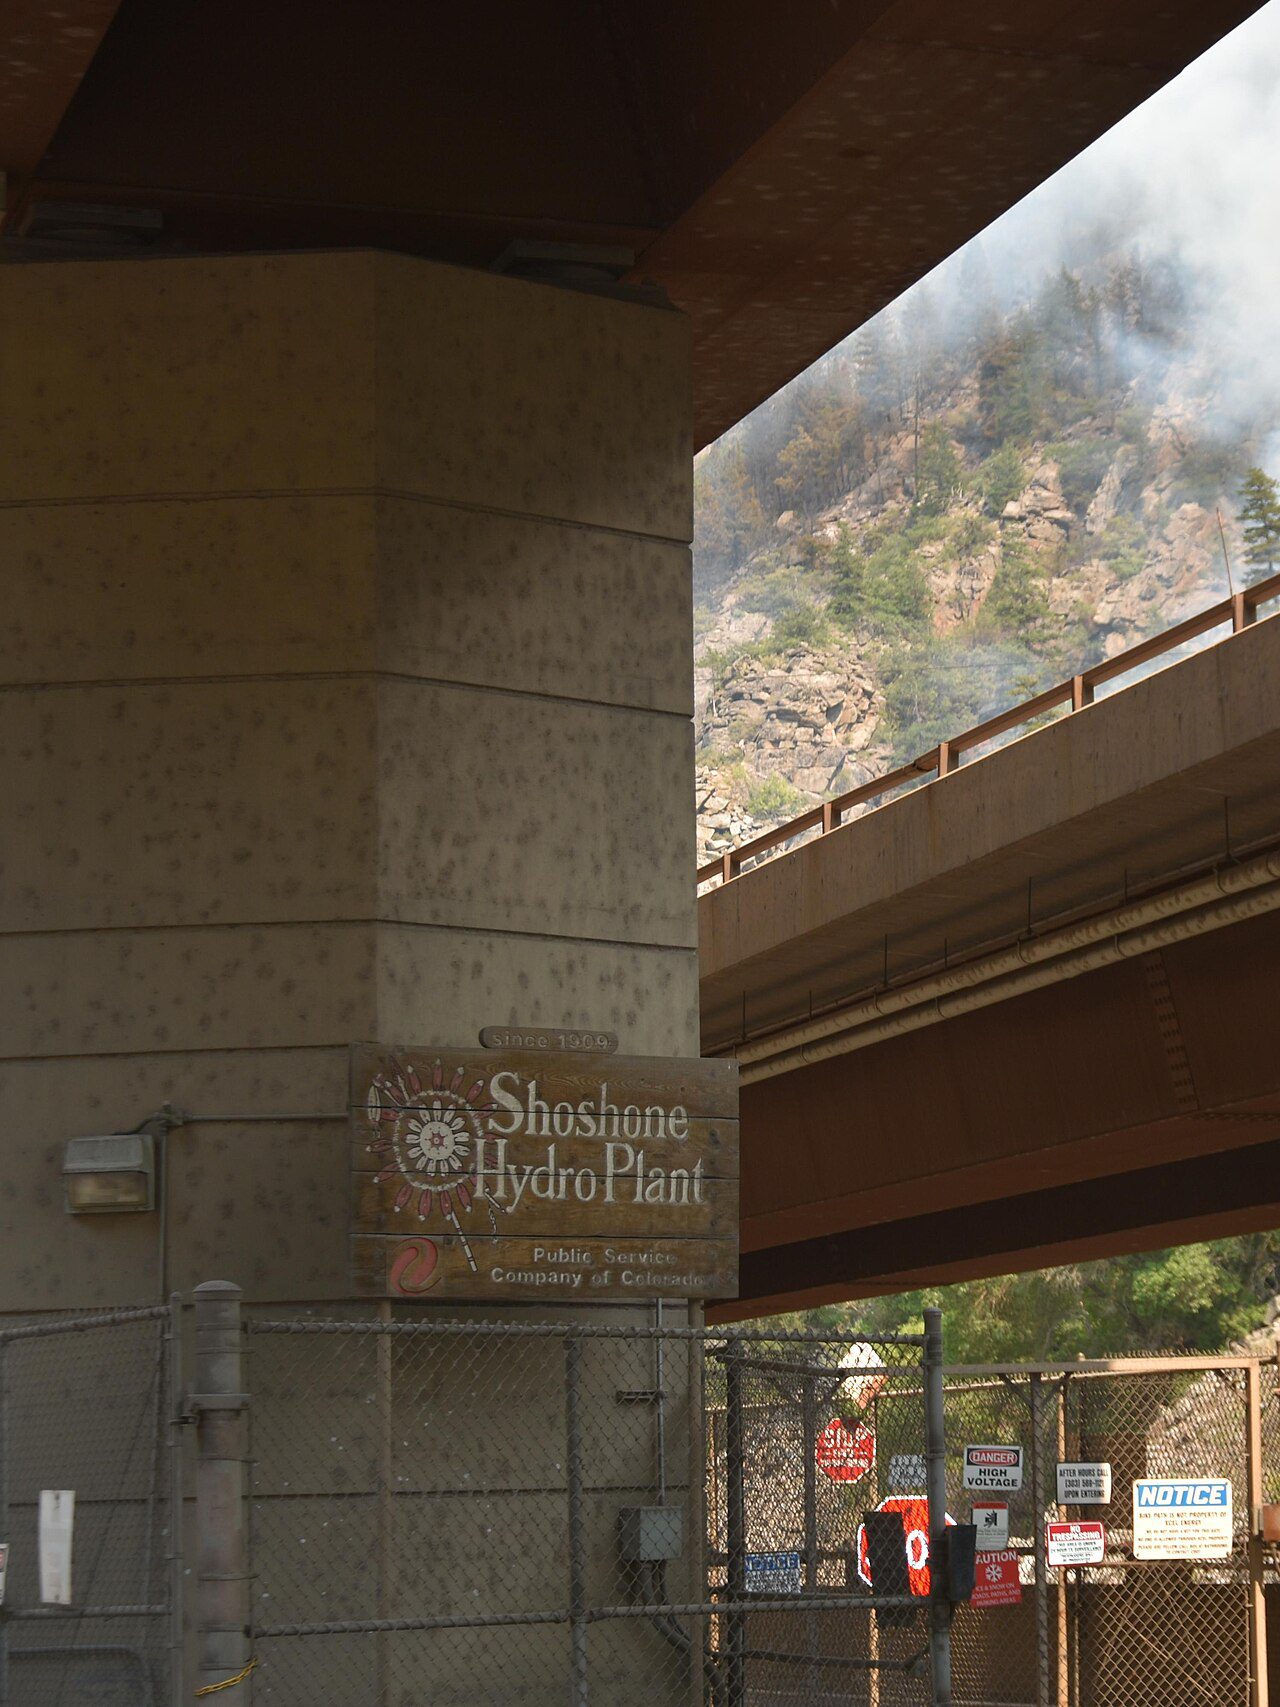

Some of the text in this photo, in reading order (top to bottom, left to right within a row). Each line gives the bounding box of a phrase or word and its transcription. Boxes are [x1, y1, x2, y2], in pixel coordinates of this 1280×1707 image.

[493, 1031, 609, 1049] since 1909
[488, 1071, 689, 1139] Shoshone
[473, 1138, 706, 1214] Hydro Plant
[533, 1248, 678, 1264] Public Service
[491, 1267, 704, 1287] Company of Colorado
[972, 1452, 1014, 1463] DANGER
[979, 1468, 1007, 1477] HIGH
[1060, 1468, 1108, 1477] AFTER HOURS CALL
[967, 1477, 1018, 1487] VOLTAGE
[1064, 1489, 1105, 1498] UPON ENTERING
[1140, 1485, 1225, 1506] NOTICE
[1070, 1525, 1081, 1533] NO
[1051, 1531, 1101, 1541] TRESPASSING
[975, 1551, 1017, 1565] AUTION
